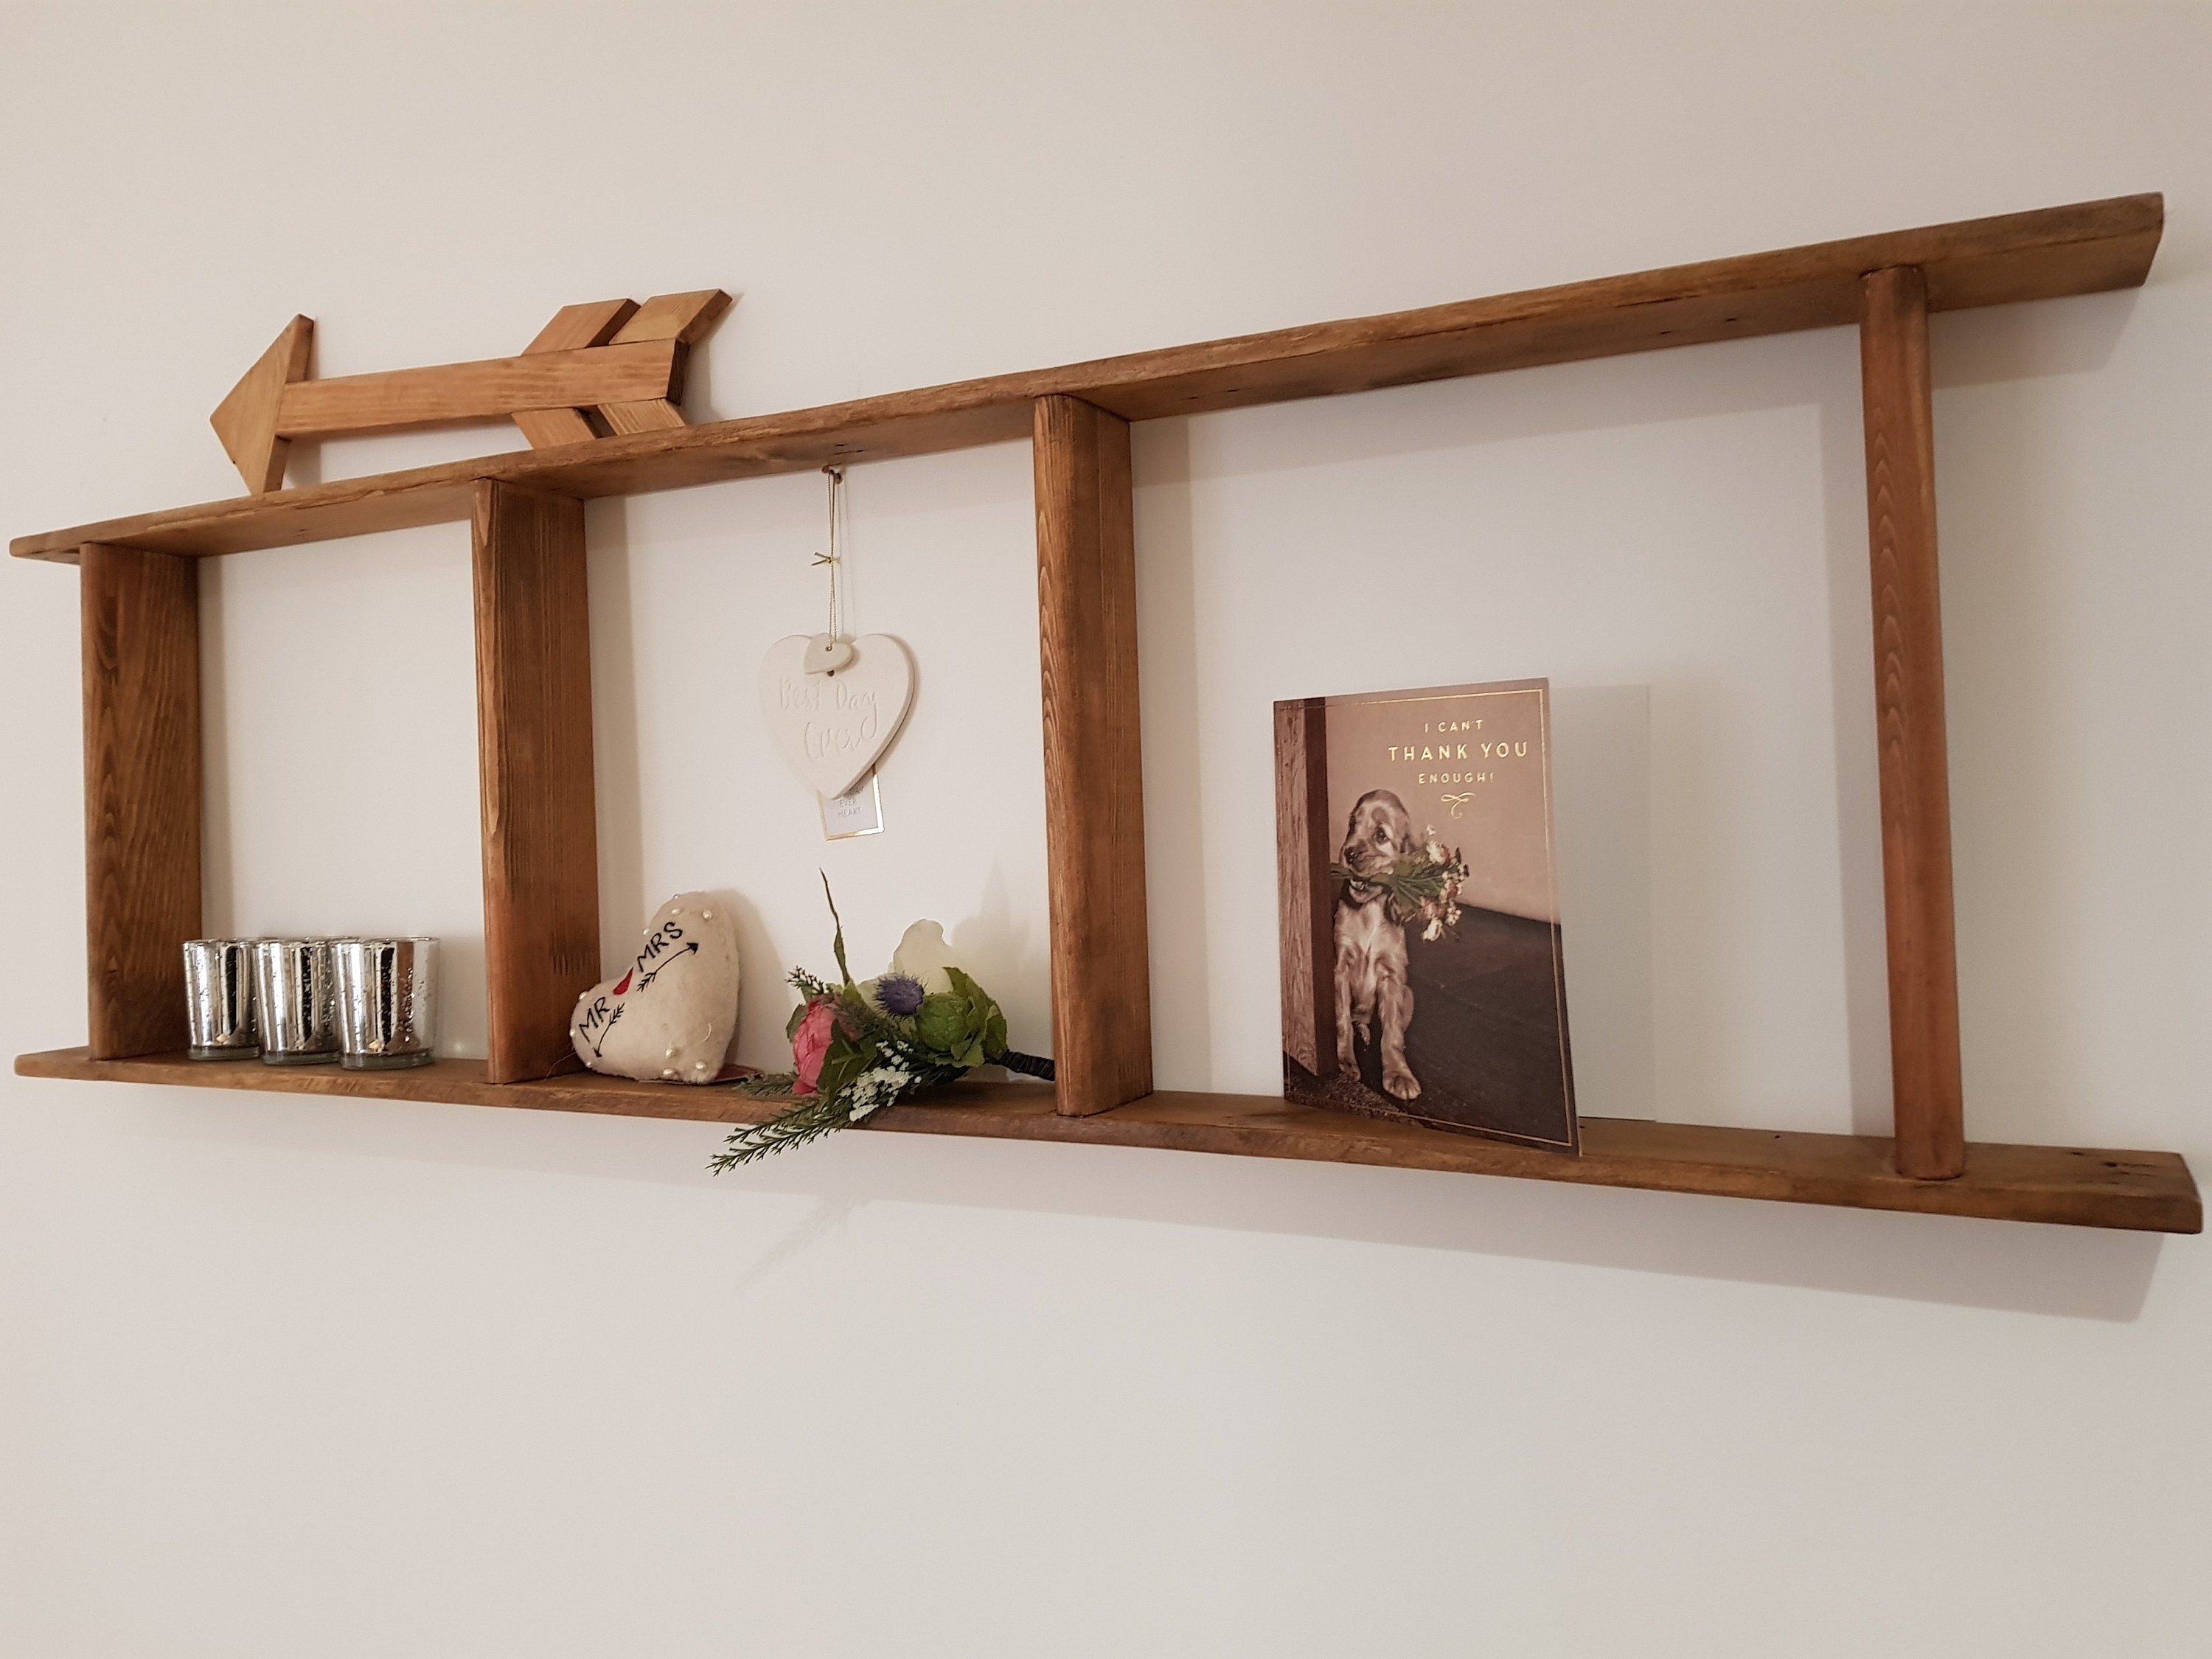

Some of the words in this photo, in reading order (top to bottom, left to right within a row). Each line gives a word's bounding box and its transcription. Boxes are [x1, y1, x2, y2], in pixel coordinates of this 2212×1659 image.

[779, 678, 821, 711] Best
[835, 683, 879, 740] Day
[1424, 723, 1429, 733] I
[1388, 743, 1469, 762] THANK
[1480, 741, 1528, 759] YOU
[1417, 772, 1495, 785] ENOUGH!
[578, 995, 611, 1044] MR
[636, 921, 684, 973] MRS
